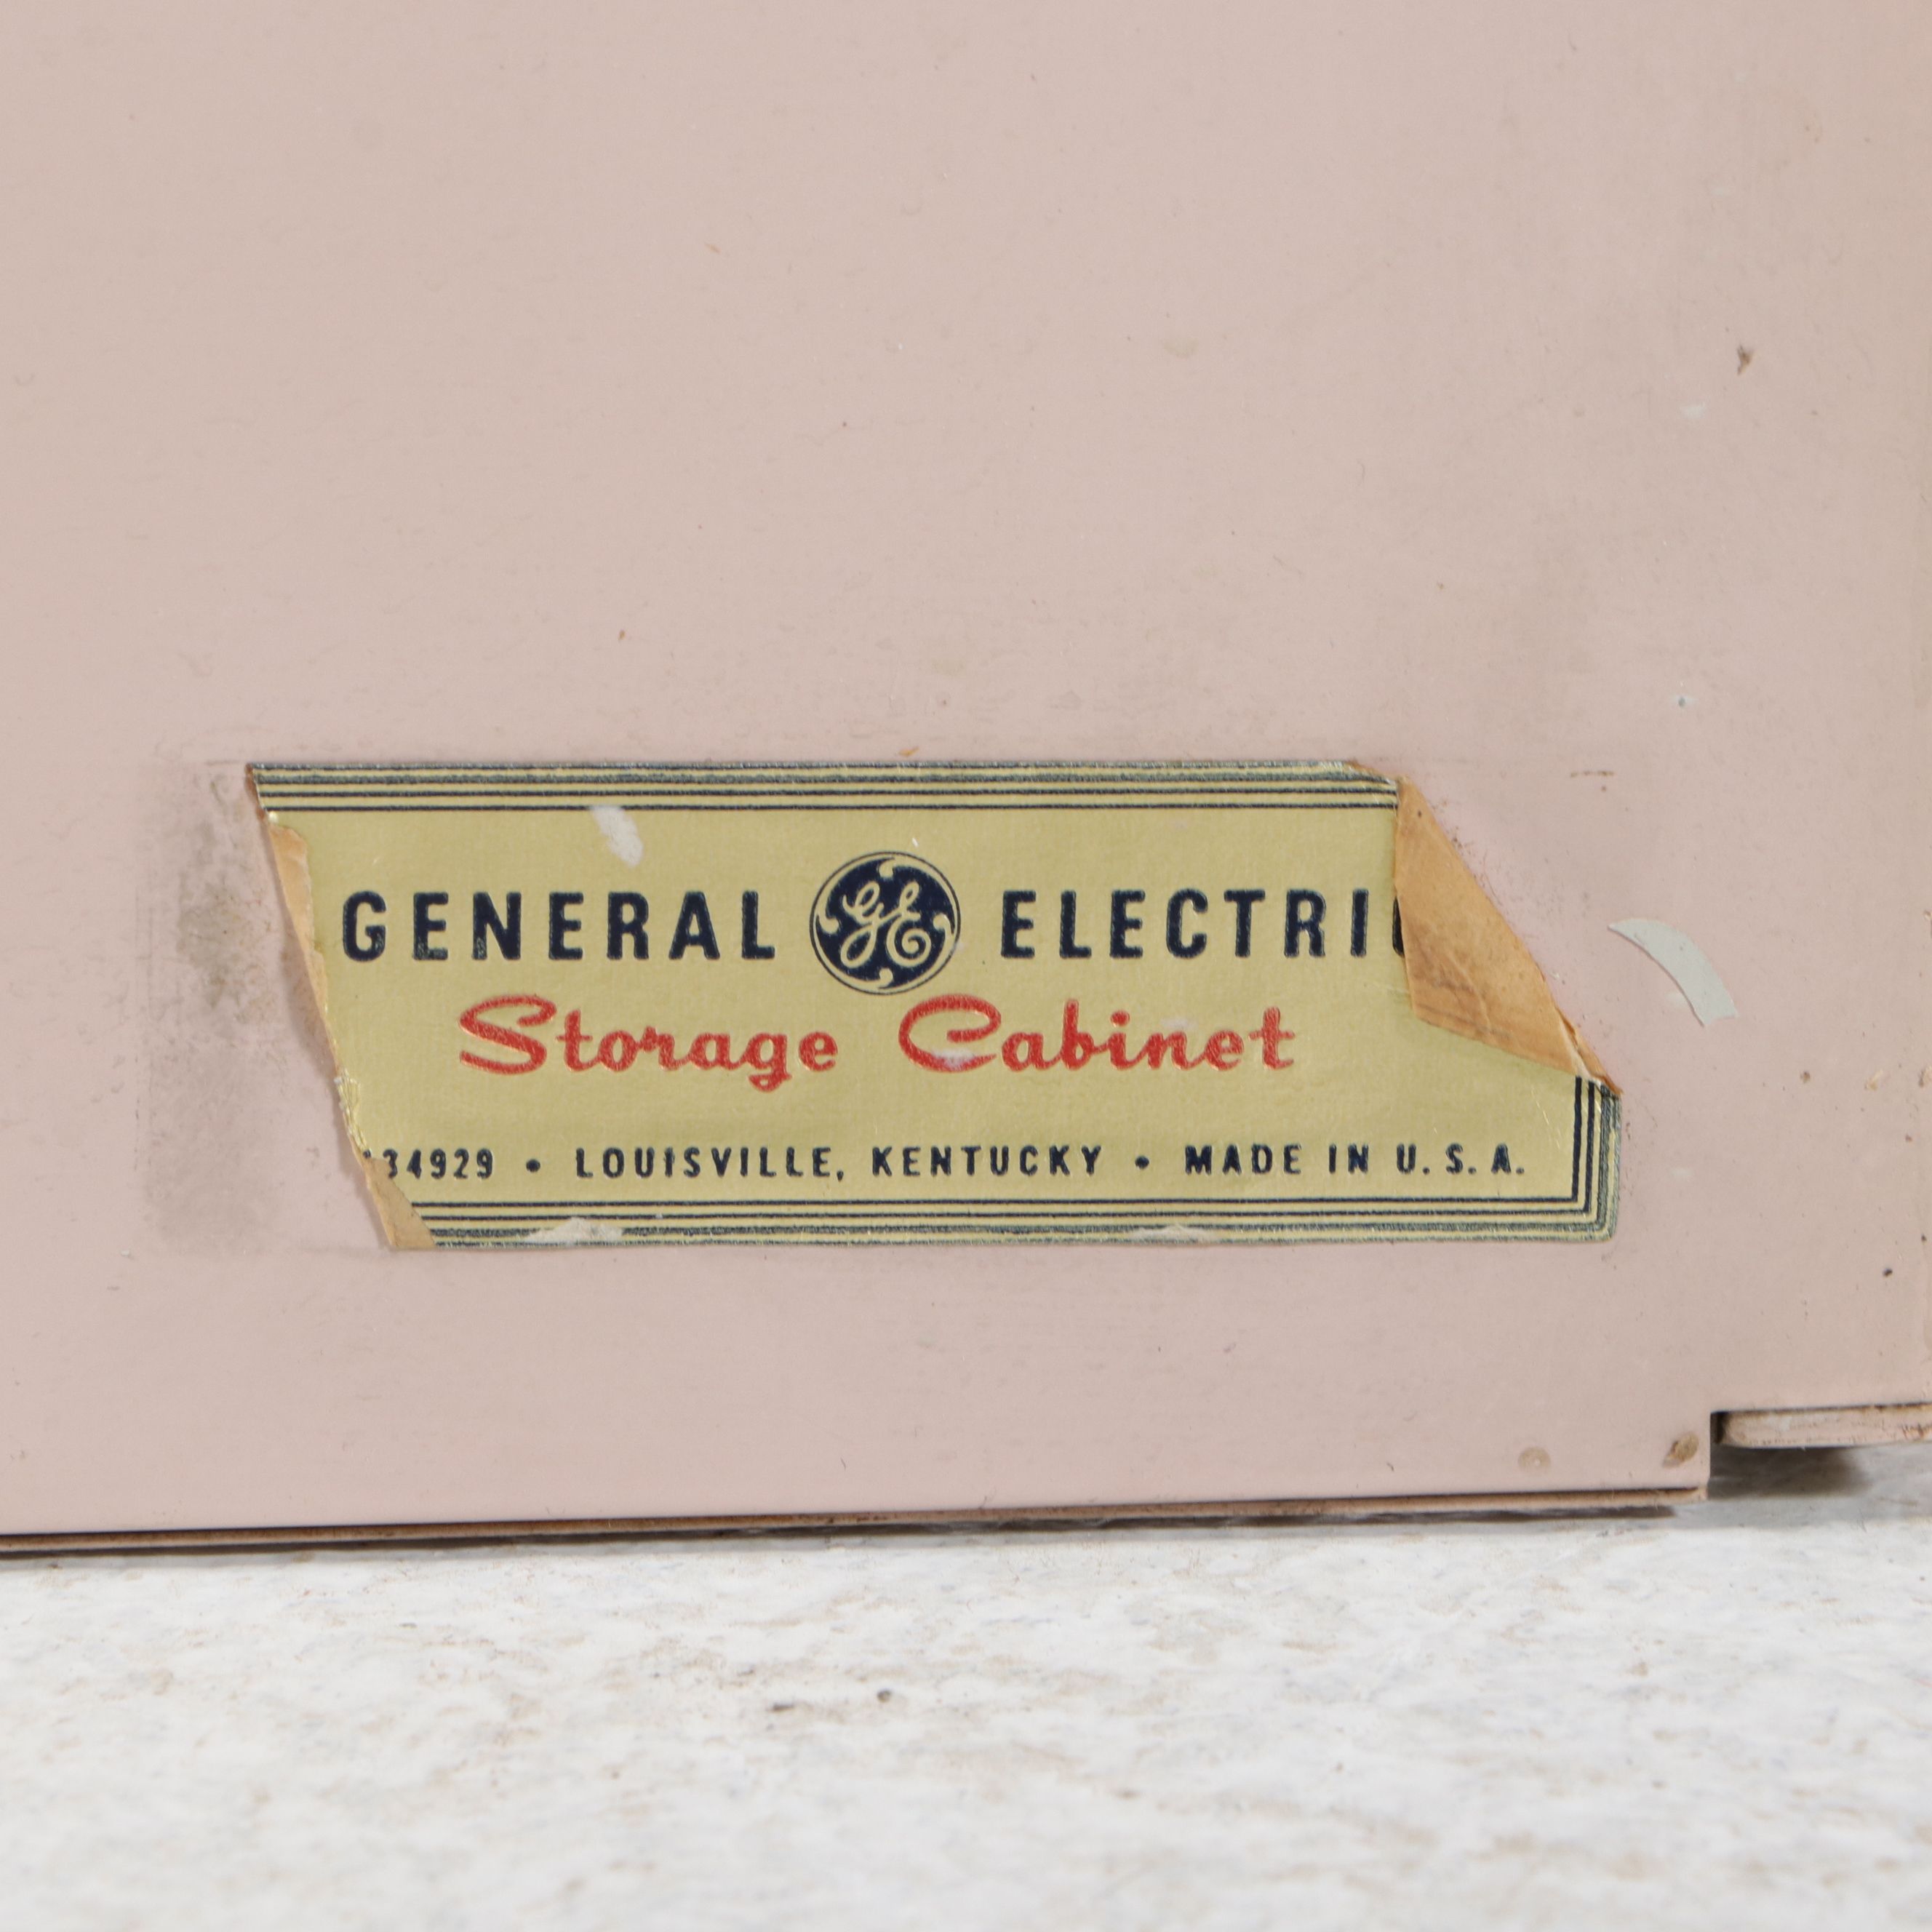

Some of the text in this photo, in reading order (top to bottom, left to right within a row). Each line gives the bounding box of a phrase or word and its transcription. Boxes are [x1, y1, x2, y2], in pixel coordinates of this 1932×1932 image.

[342, 890, 776, 962] GENERAL
[999, 888, 1405, 959] ELECTRI
[460, 995, 1293, 1091] Storage Cabinet
[363, 1143, 1525, 1181] 34929 LOUISVILLE, KENTUCKY MADE IN U.S.A.
